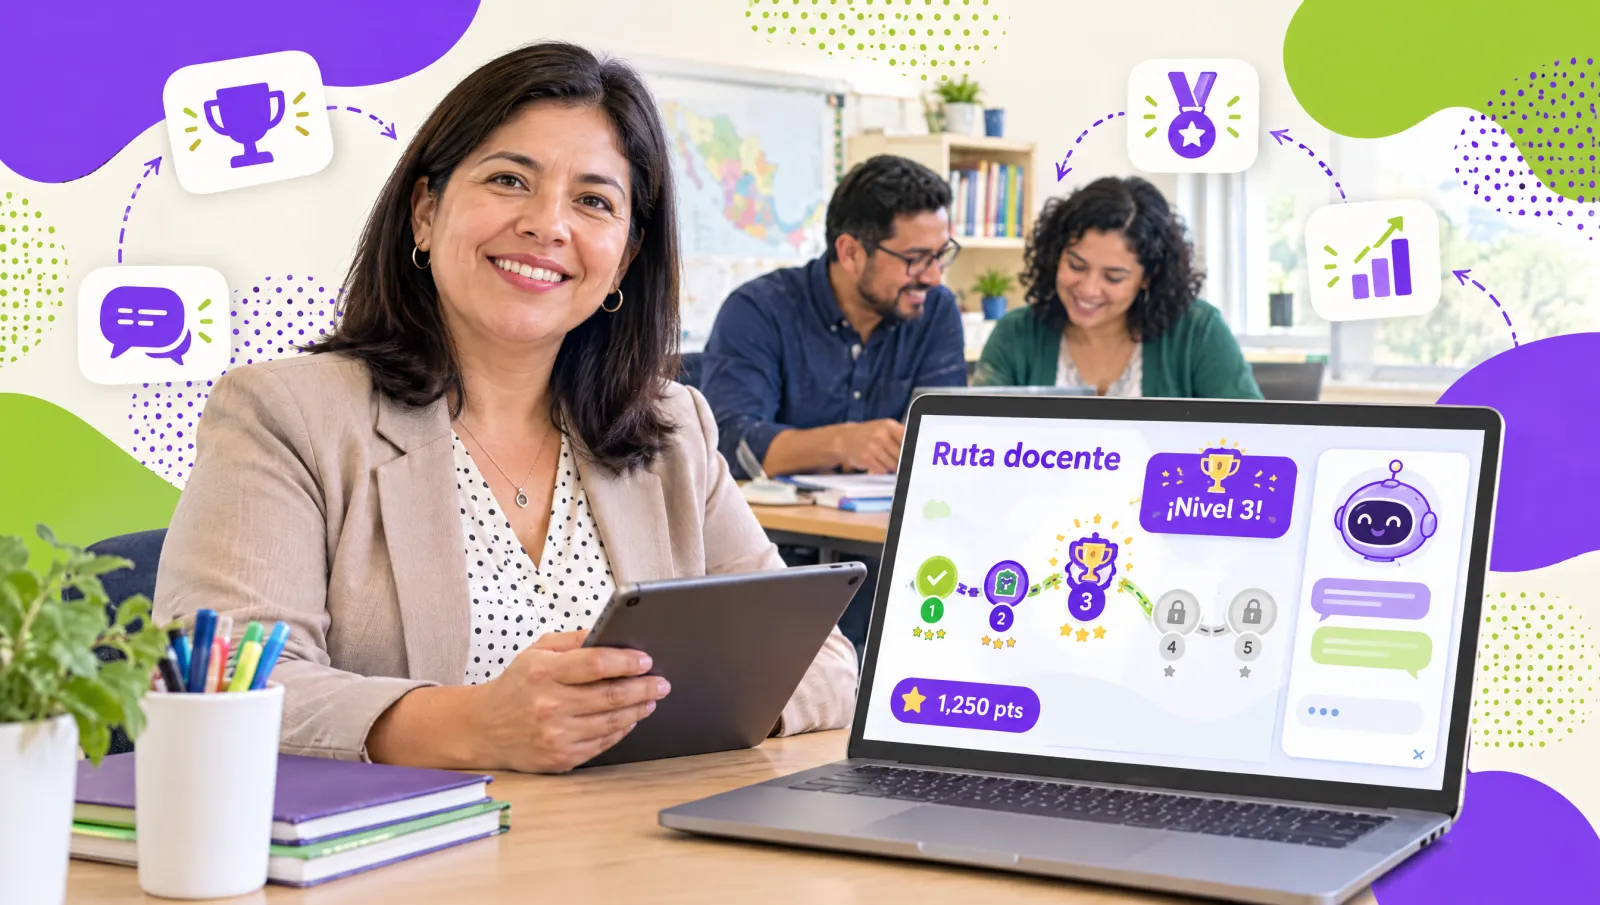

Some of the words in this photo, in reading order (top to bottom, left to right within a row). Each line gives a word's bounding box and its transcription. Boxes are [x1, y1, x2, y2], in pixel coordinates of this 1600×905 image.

[932, 441, 995, 469] Ruta
[1003, 441, 1121, 471] docente
[1166, 496, 1234, 522] ¡Nivel
[1239, 499, 1263, 521] 3!
[1080, 591, 1093, 611] 3
[928, 604, 936, 618] 1
[996, 611, 1006, 626] 2
[1167, 640, 1177, 654] 4
[1243, 640, 1253, 655] 5
[937, 693, 990, 717] 1,250
[993, 698, 1024, 722] pts
